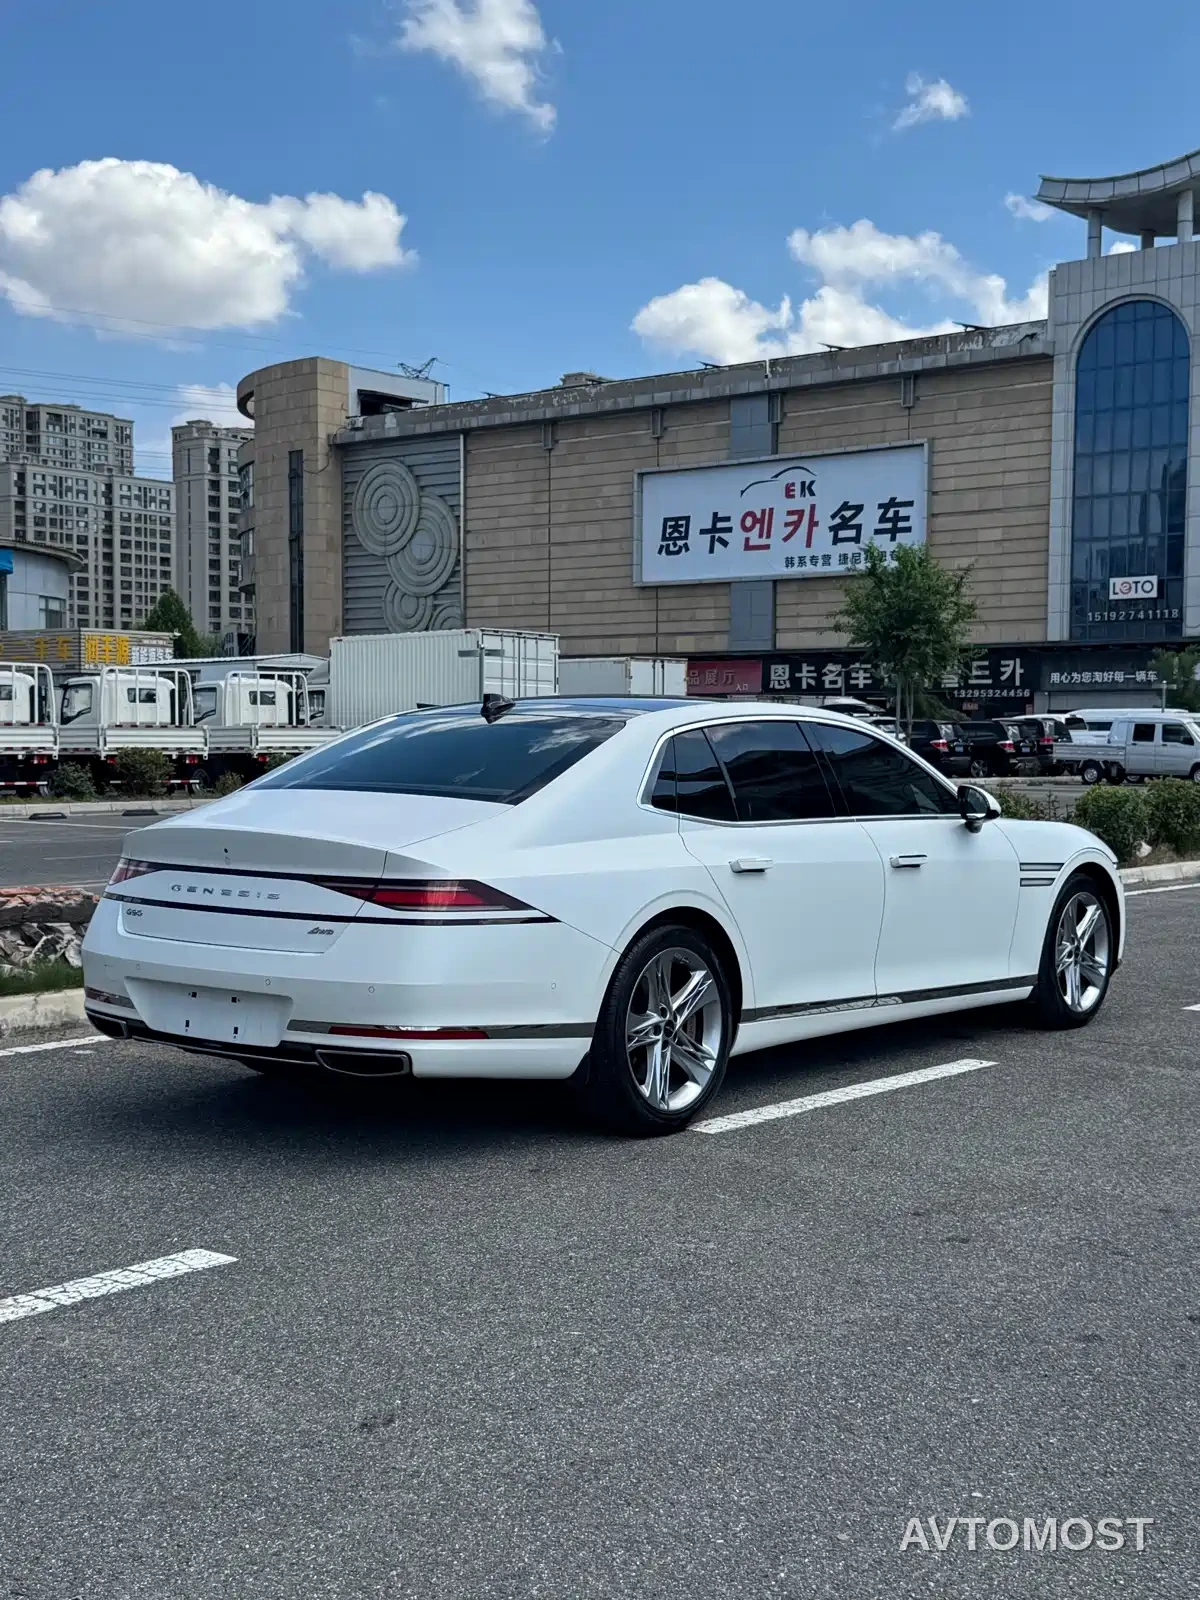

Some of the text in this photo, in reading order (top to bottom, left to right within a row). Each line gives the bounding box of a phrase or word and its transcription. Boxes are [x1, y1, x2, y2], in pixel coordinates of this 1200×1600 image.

[785, 480, 816, 499] EK
[784, 554, 832, 569] 韩系专营
[1088, 609, 1179, 621] 15192741118
[769, 663, 873, 689] 恩卡名车
[1050, 671, 1158, 683] 用心为您淘好每一辆车
[953, 689, 1030, 698] 13295324456
[171, 884, 280, 900] GENESIS
